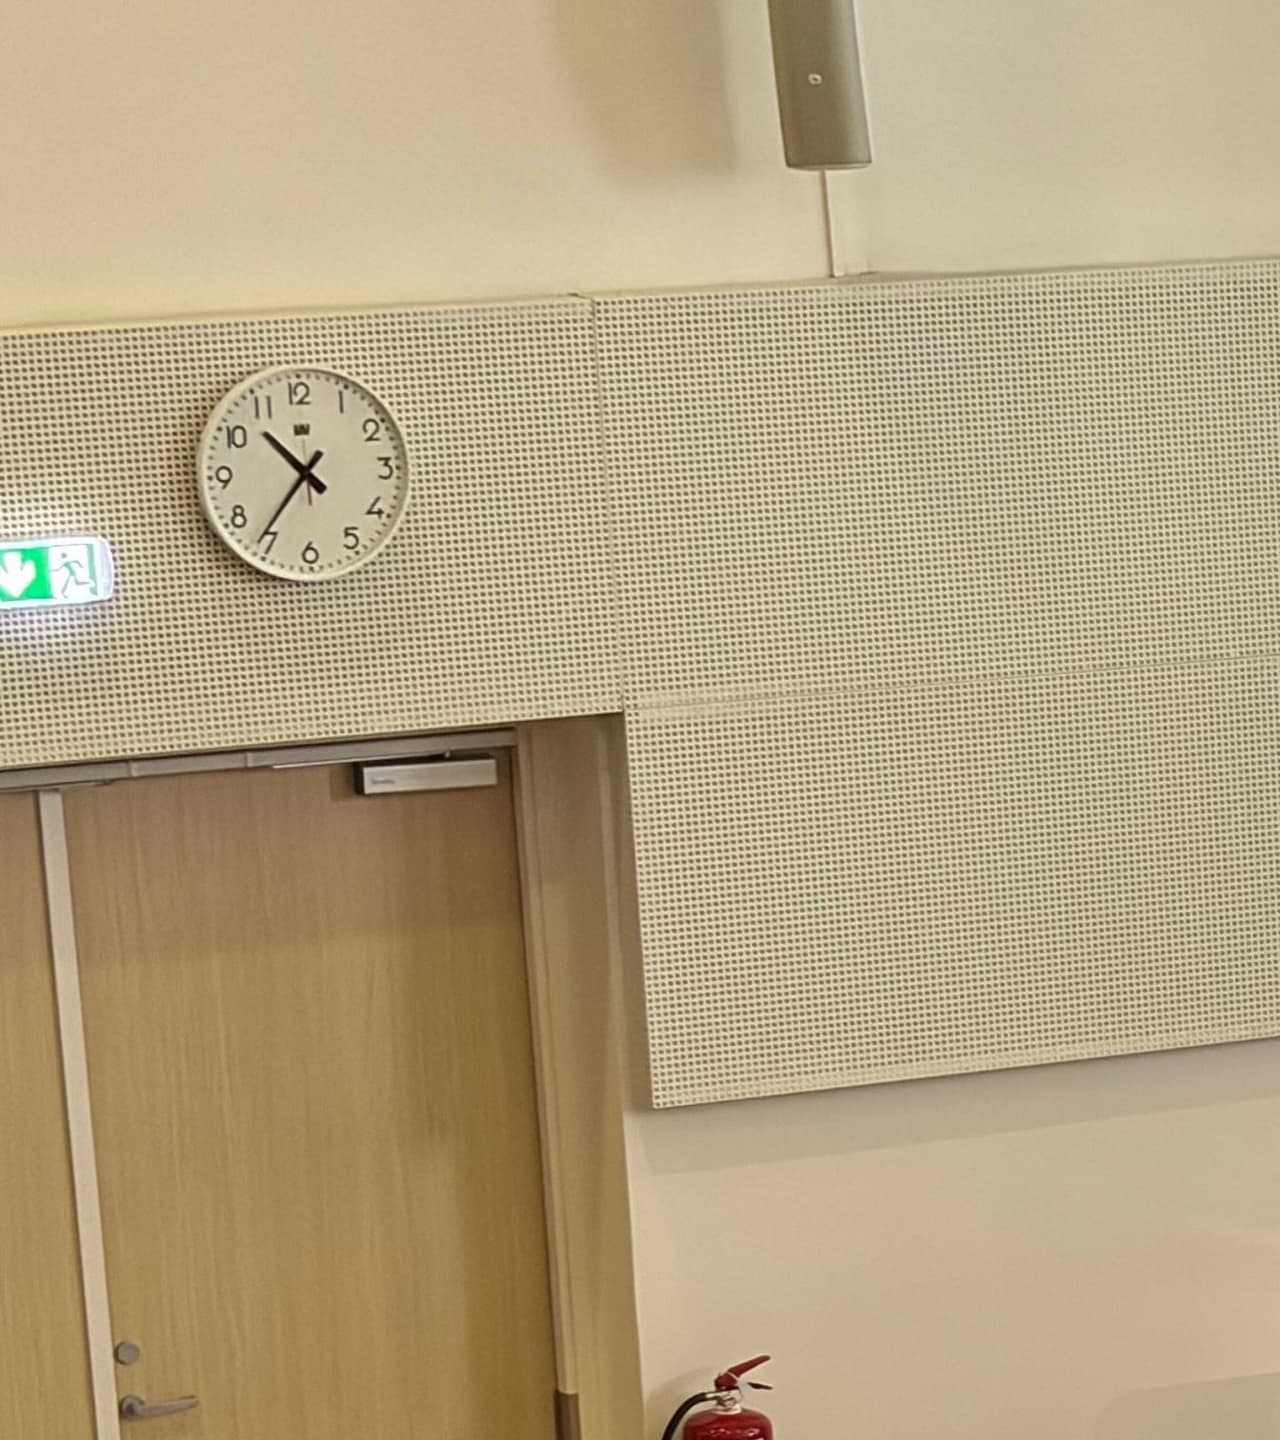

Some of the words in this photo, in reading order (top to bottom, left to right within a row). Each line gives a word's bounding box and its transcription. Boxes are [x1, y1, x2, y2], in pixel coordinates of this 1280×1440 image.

[287, 381, 312, 406] 12
[254, 395, 272, 420] 11
[225, 424, 248, 449] 10
[362, 418, 381, 442] 2
[214, 465, 234, 490] 9
[376, 456, 394, 480] 3
[230, 504, 248, 529] 8
[364, 496, 385, 519] 4
[262, 531, 279, 555] 7
[342, 526, 360, 550] 5
[301, 541, 320, 565] 6
